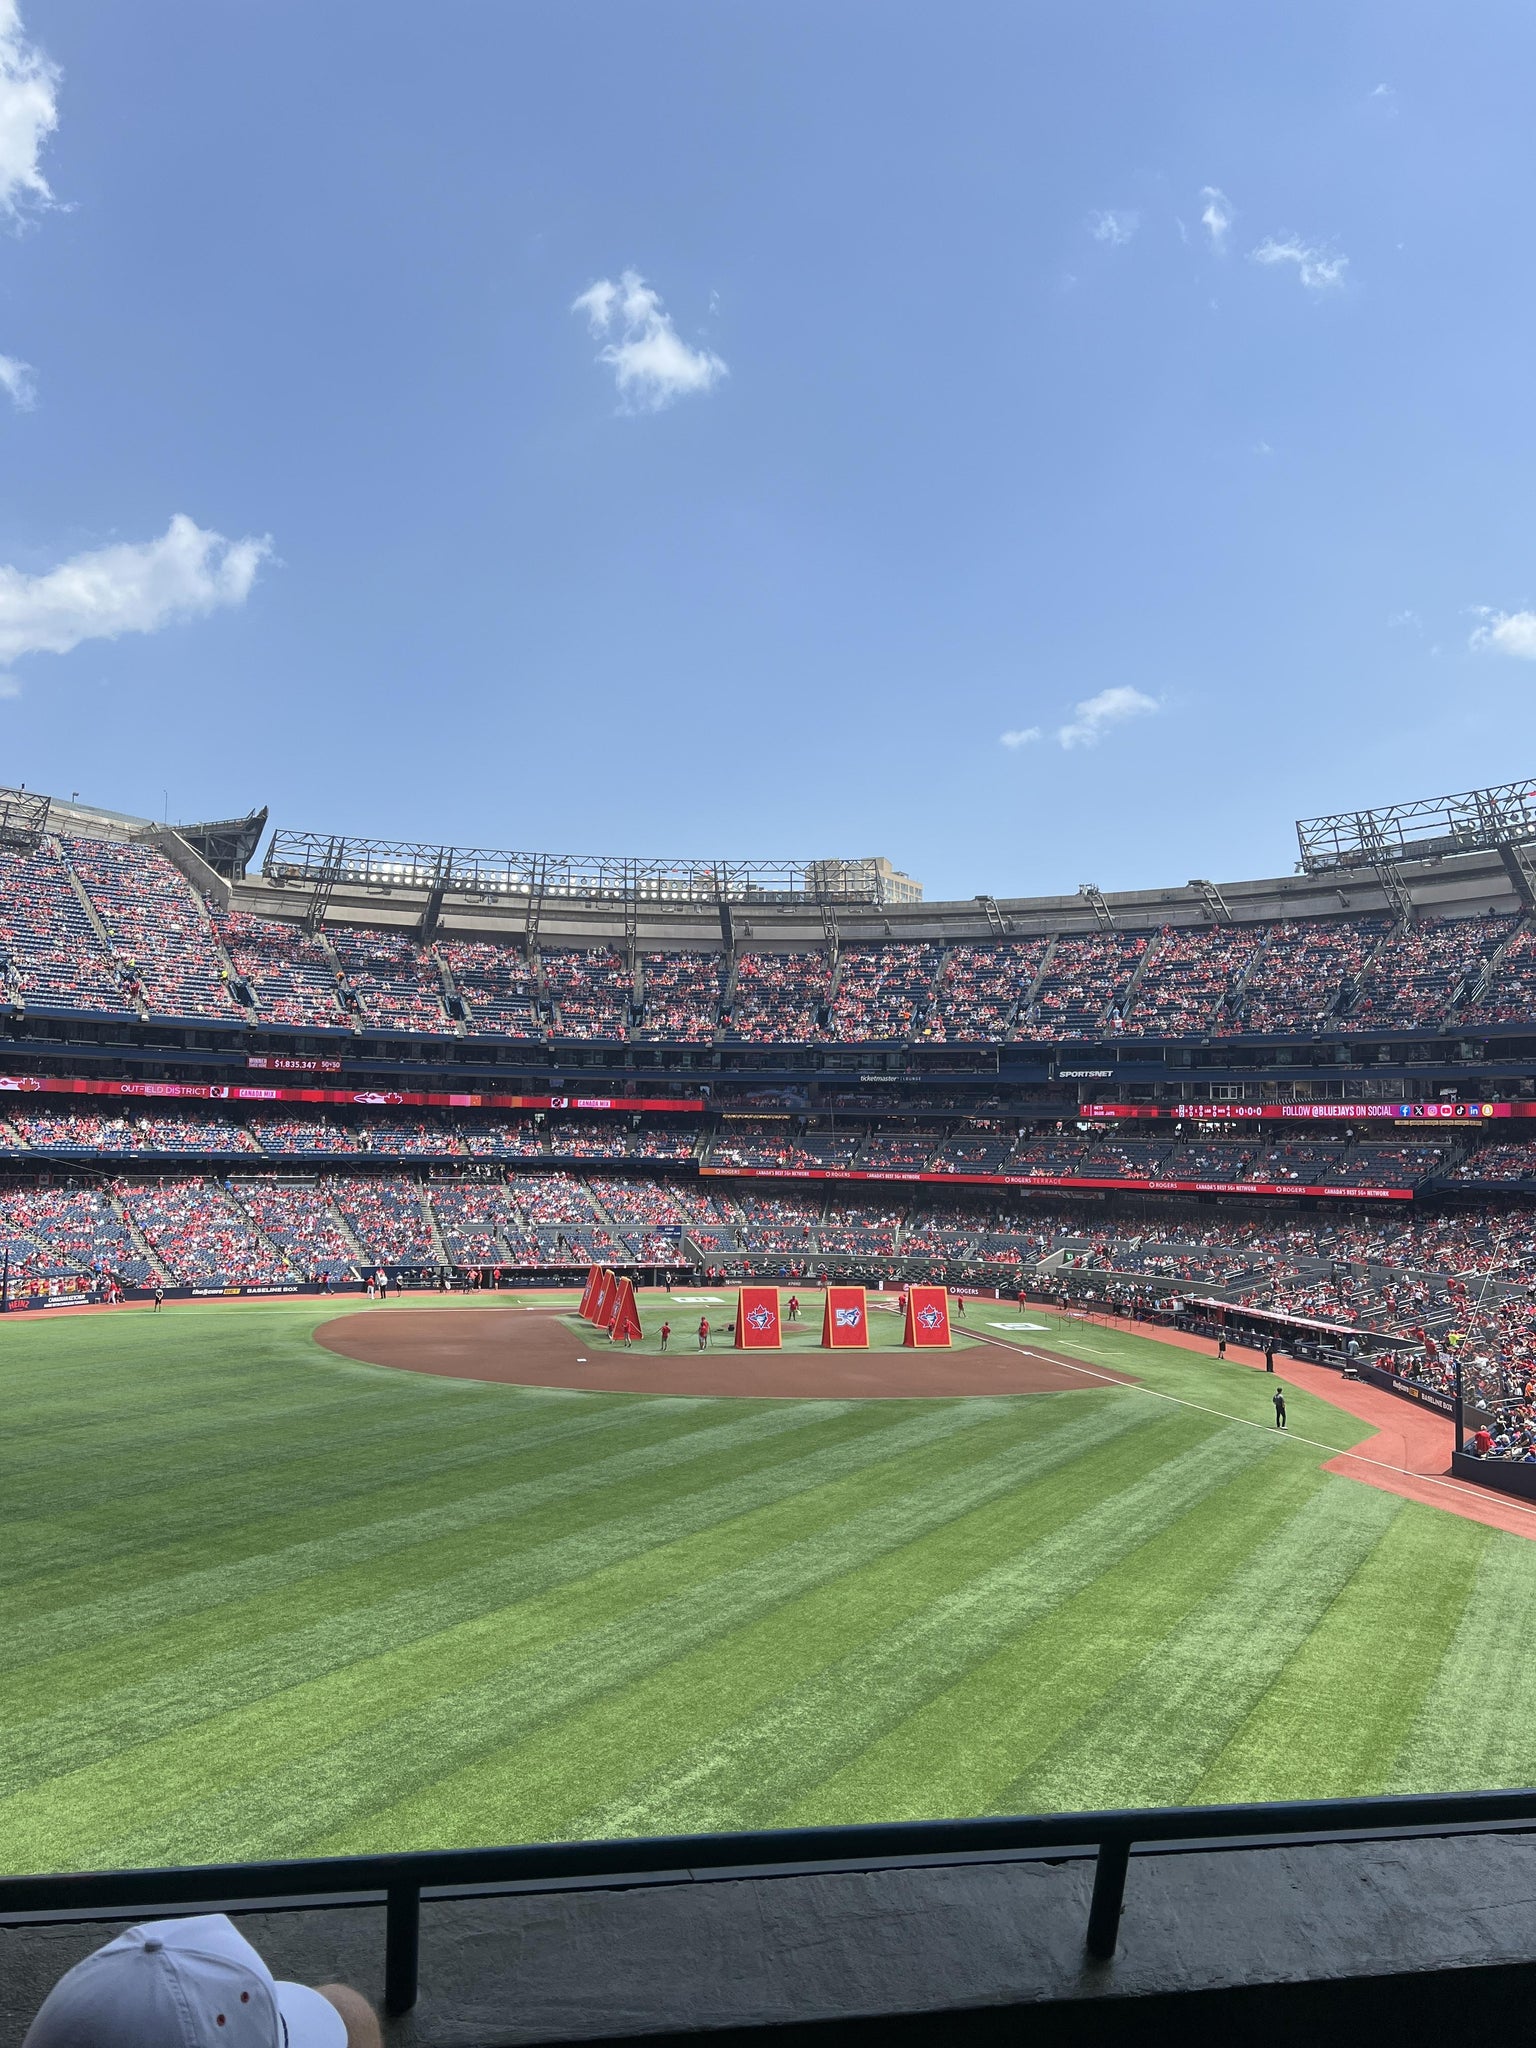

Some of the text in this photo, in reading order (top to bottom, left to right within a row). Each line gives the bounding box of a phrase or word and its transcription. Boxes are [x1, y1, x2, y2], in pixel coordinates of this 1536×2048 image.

[860, 1074, 898, 1082] ticketmaster
[1059, 1070, 1114, 1078] SPORTSNET
[120, 1084, 208, 1096] OUTFIELD DISTRICT
[240, 1089, 276, 1098] CANADA MIX
[1282, 1106, 1393, 1117] FOLLOW @BLUEJAYS ON SOCIAL
[8, 1300, 30, 1310] HEINZ
[1421, 1392, 1443, 1408] BASELINE
[1442, 1401, 1453, 1412] BOX
